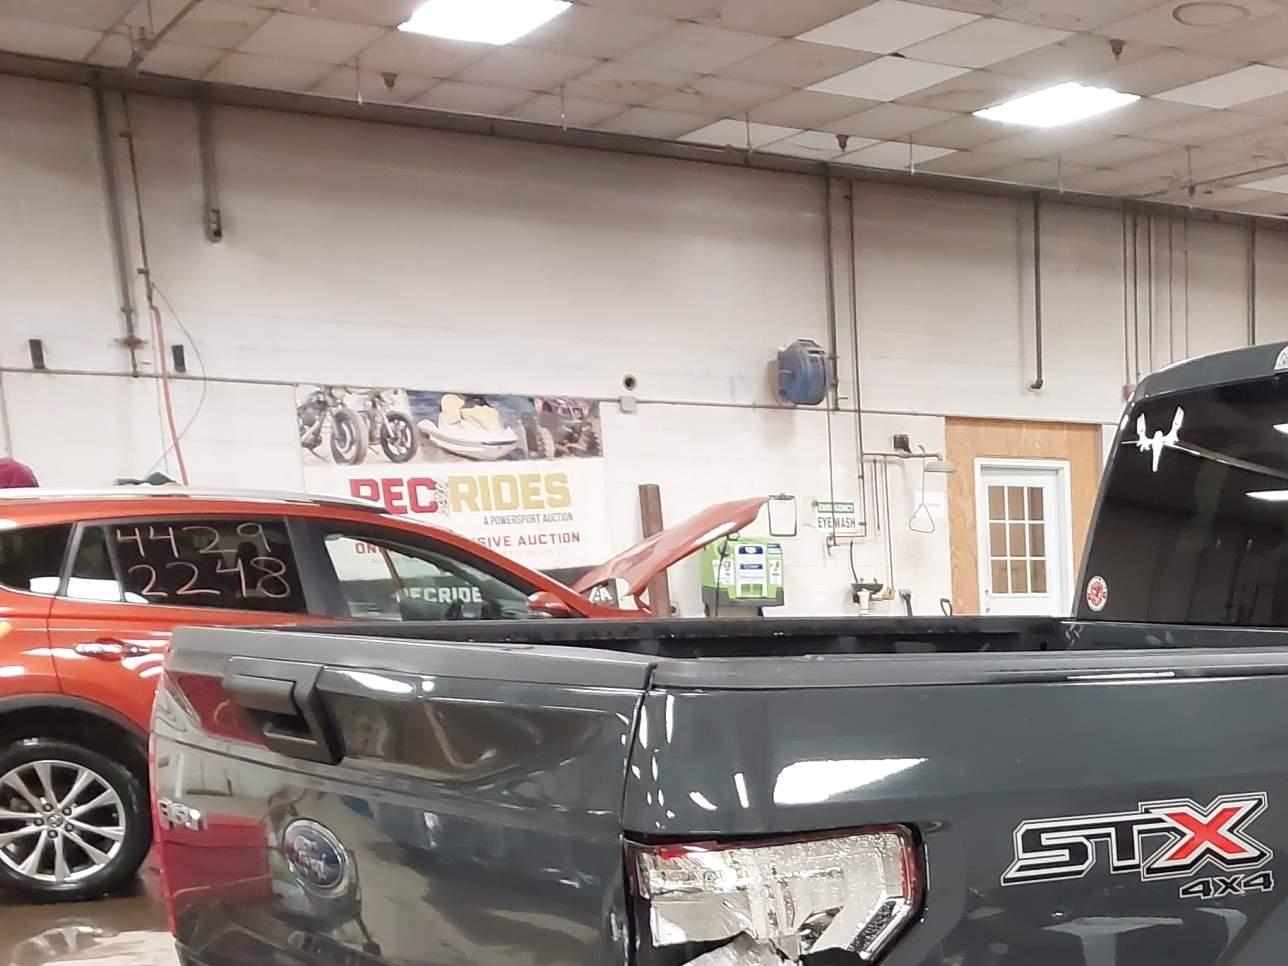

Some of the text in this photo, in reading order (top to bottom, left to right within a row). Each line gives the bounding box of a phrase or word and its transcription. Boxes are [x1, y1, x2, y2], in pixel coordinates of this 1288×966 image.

[449, 473, 572, 513] RIDES
[491, 513, 541, 525] POWERSPORT
[542, 512, 574, 524] AUCTION
[834, 517, 856, 529] WASH
[116, 523, 272, 558] 4429
[518, 532, 581, 547] AUCTION
[128, 556, 290, 598] 2248
[1001, 792, 1273, 886] STX
